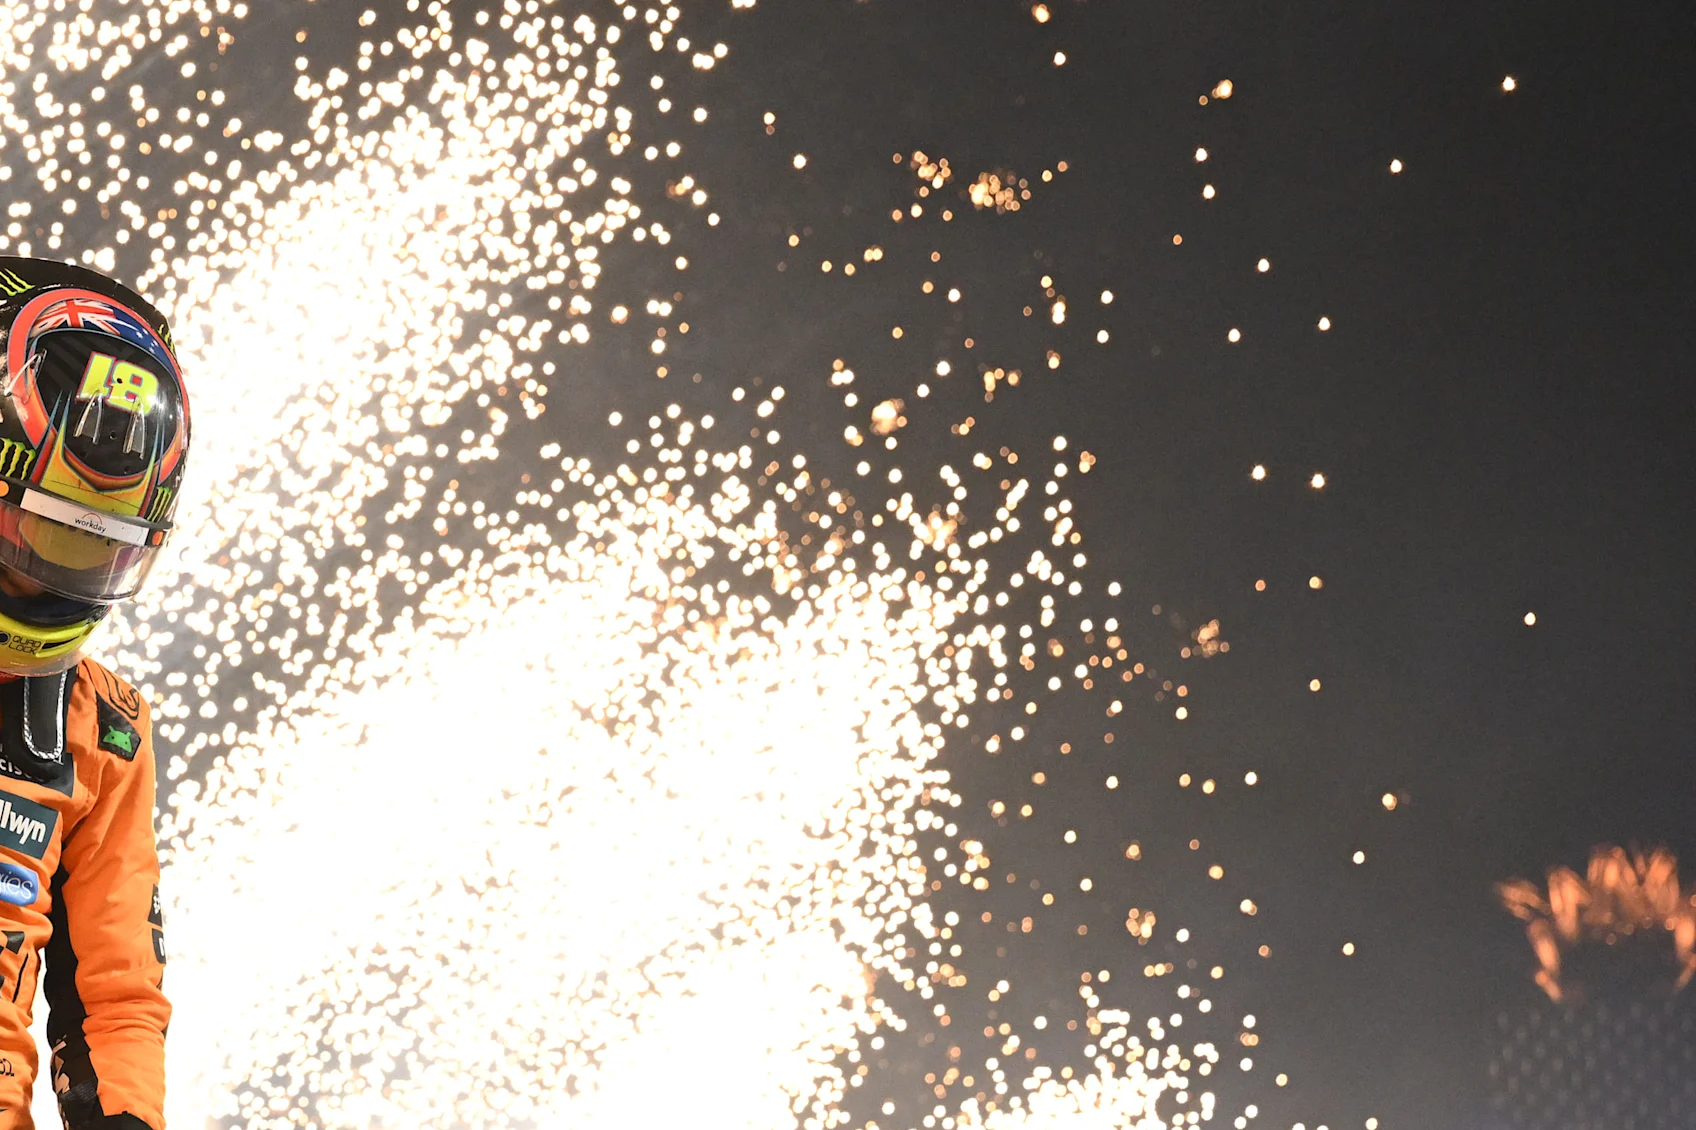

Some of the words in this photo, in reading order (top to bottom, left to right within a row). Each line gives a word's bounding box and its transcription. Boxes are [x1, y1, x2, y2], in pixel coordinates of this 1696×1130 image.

[74, 516, 107, 535] workday
[12, 635, 42, 647] QUAD
[8, 643, 38, 655] LOCK
